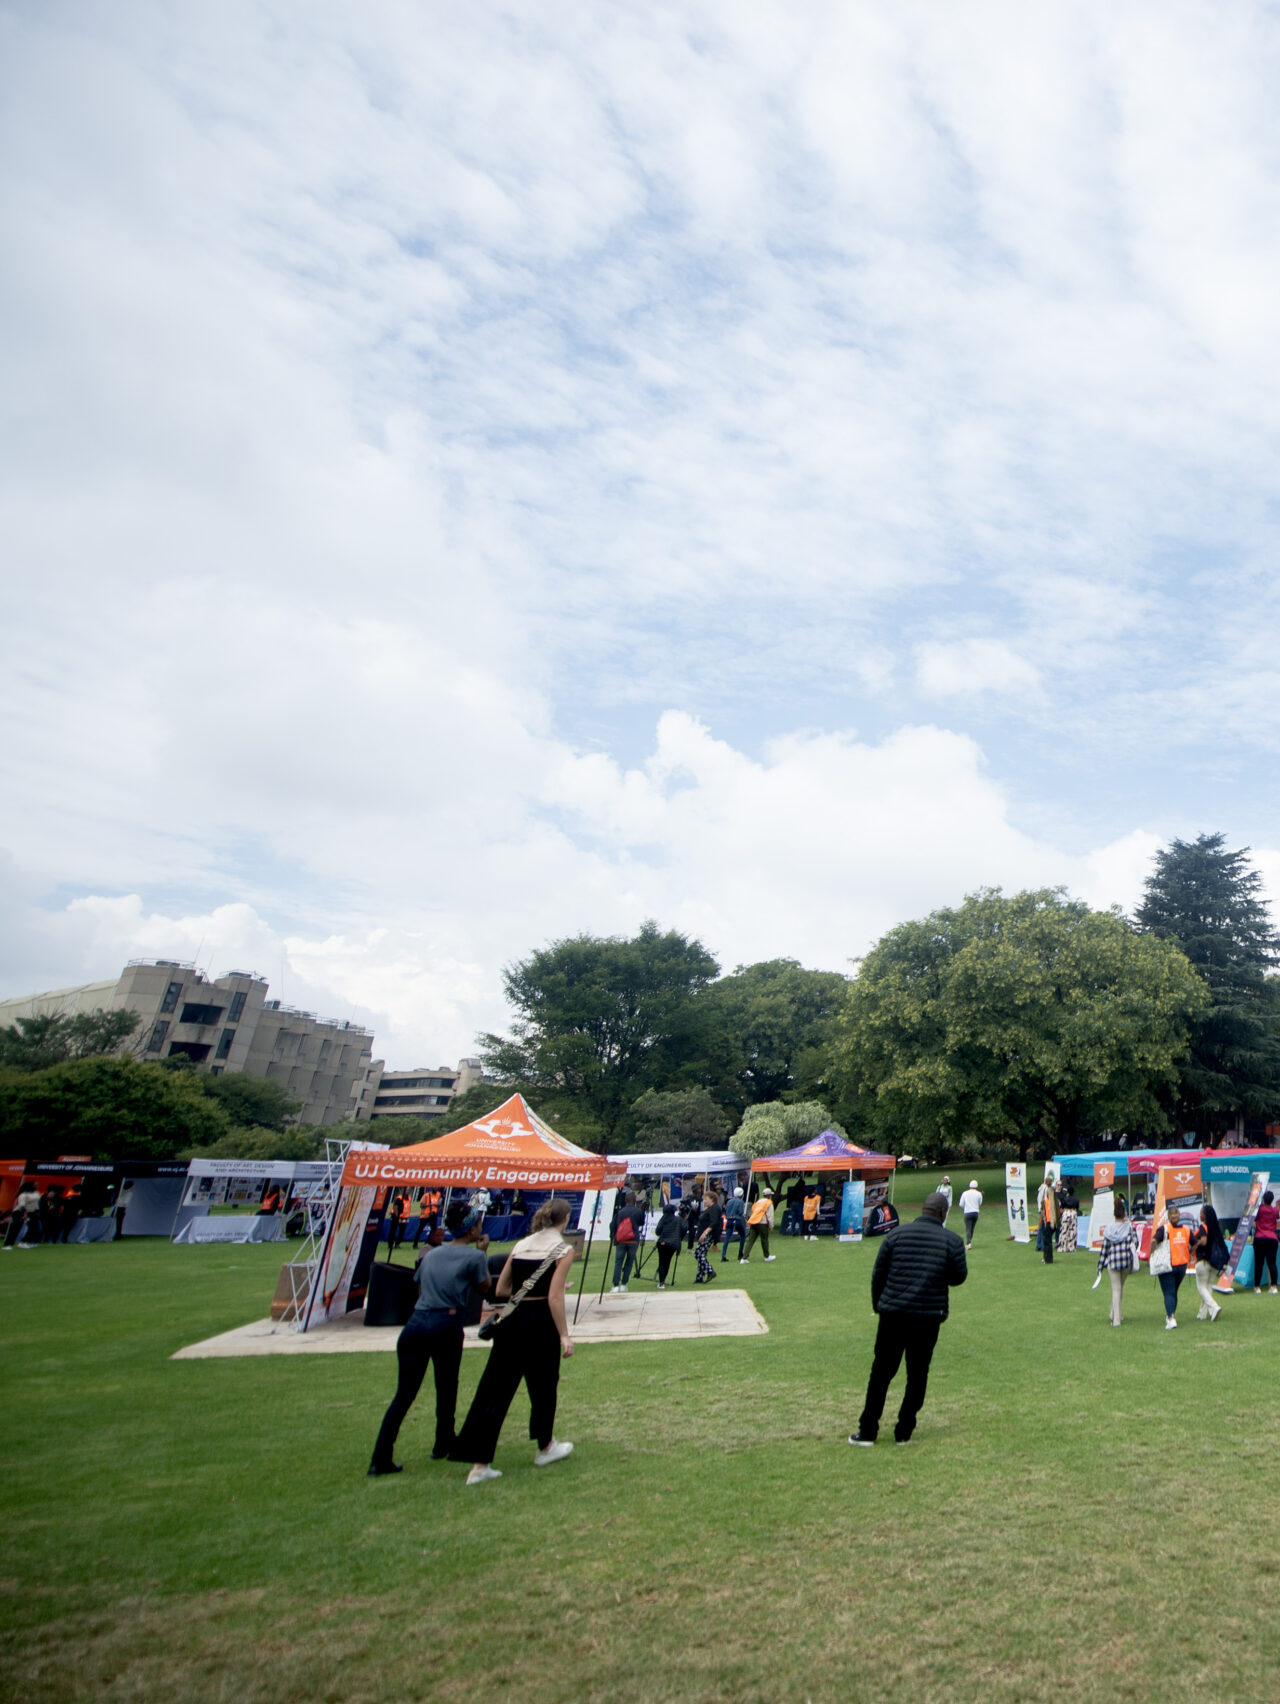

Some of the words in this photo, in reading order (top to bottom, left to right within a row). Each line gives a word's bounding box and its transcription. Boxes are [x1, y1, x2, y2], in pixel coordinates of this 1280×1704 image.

[355, 1163, 379, 1178] UJ
[380, 1164, 484, 1183] Community
[485, 1166, 592, 1185] Engagement
